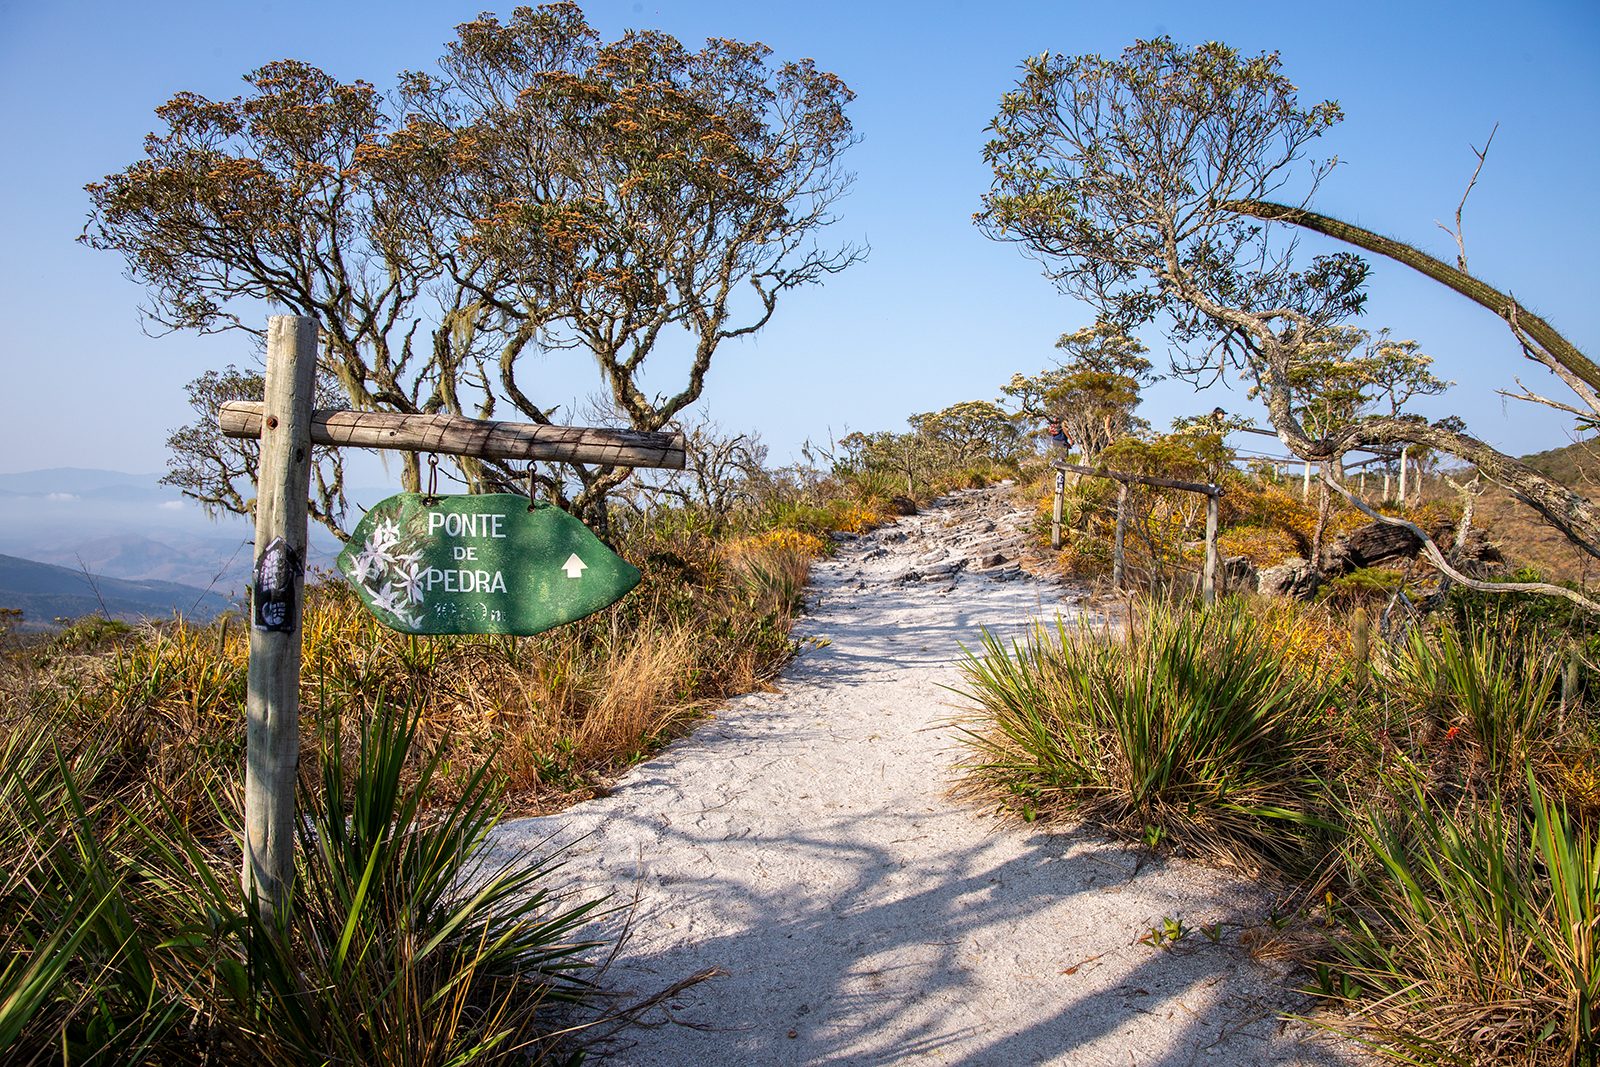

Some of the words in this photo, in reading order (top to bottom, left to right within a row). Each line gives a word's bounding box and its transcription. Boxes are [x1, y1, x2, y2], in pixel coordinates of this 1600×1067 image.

[428, 512, 506, 539] PONTE
[453, 546, 478, 561] DE
[426, 569, 507, 594] PEDRA
